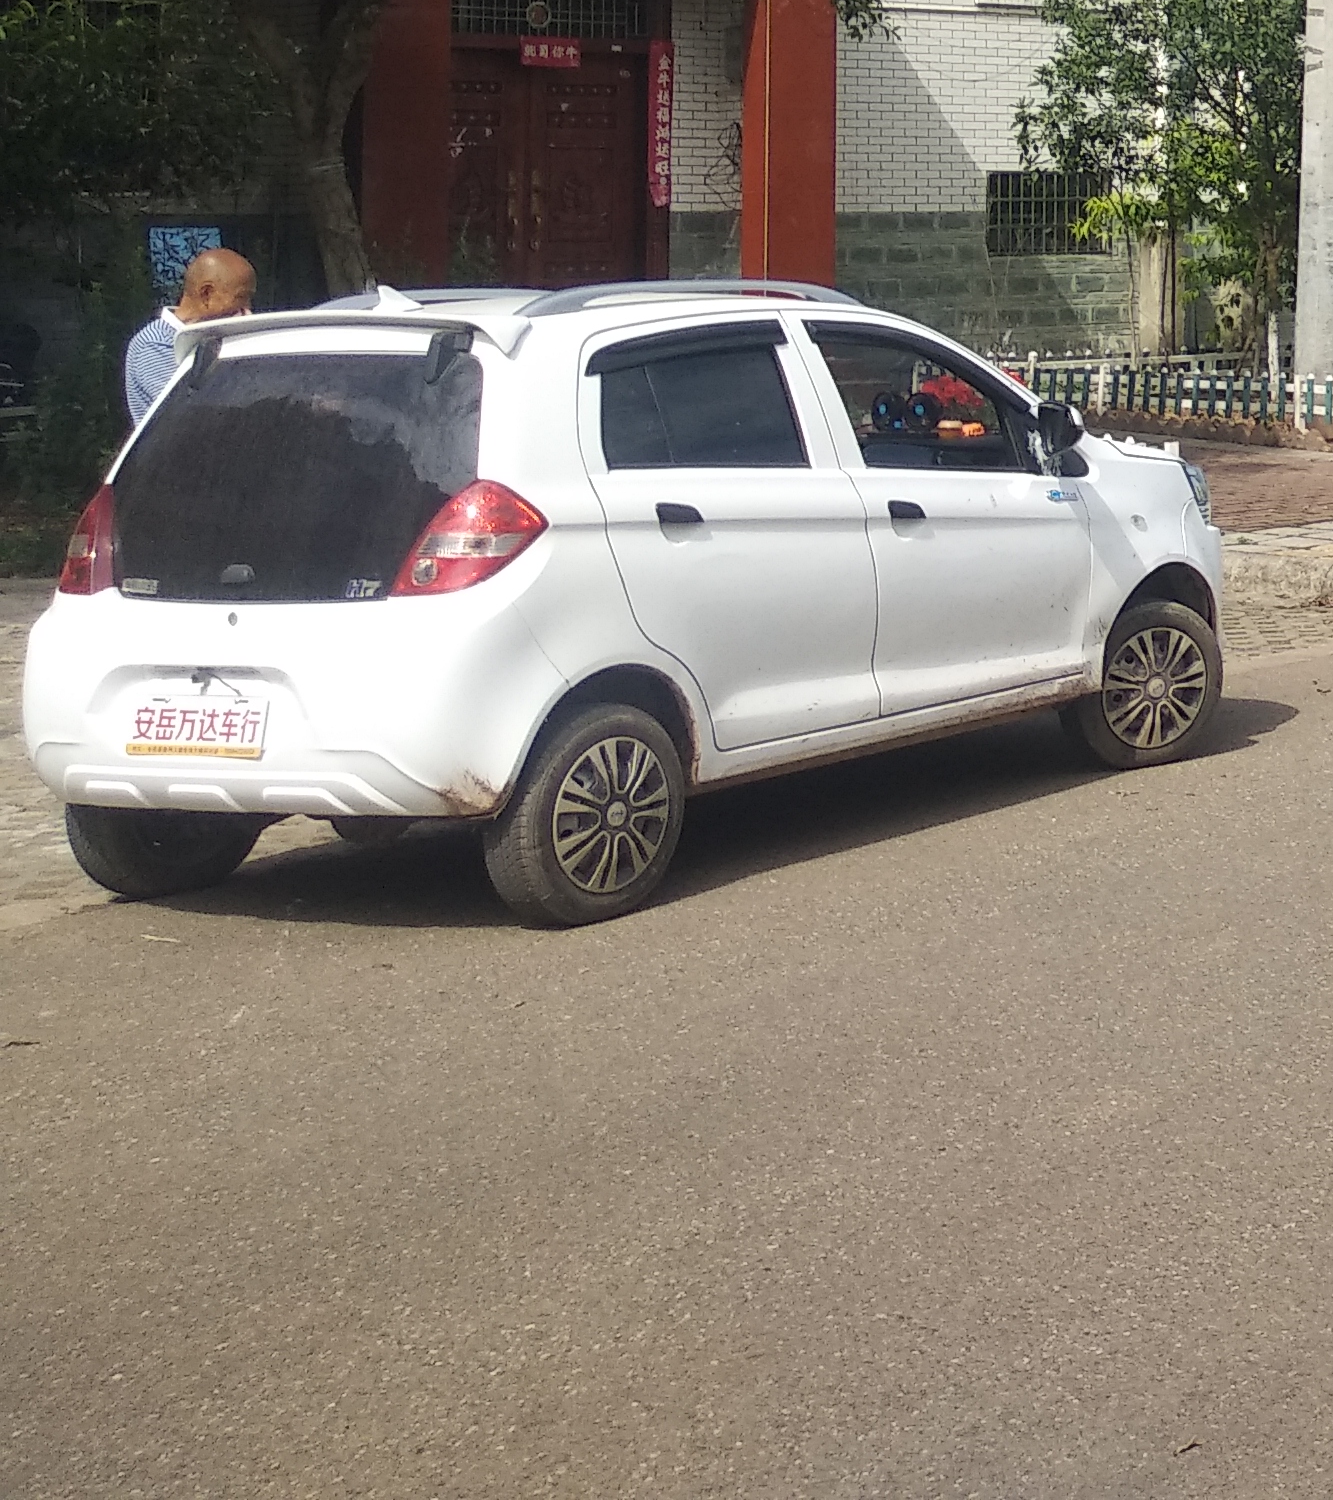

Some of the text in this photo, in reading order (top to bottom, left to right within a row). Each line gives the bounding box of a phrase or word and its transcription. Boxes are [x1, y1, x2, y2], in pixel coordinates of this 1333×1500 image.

[132, 706, 261, 743] 安岳万达车行
